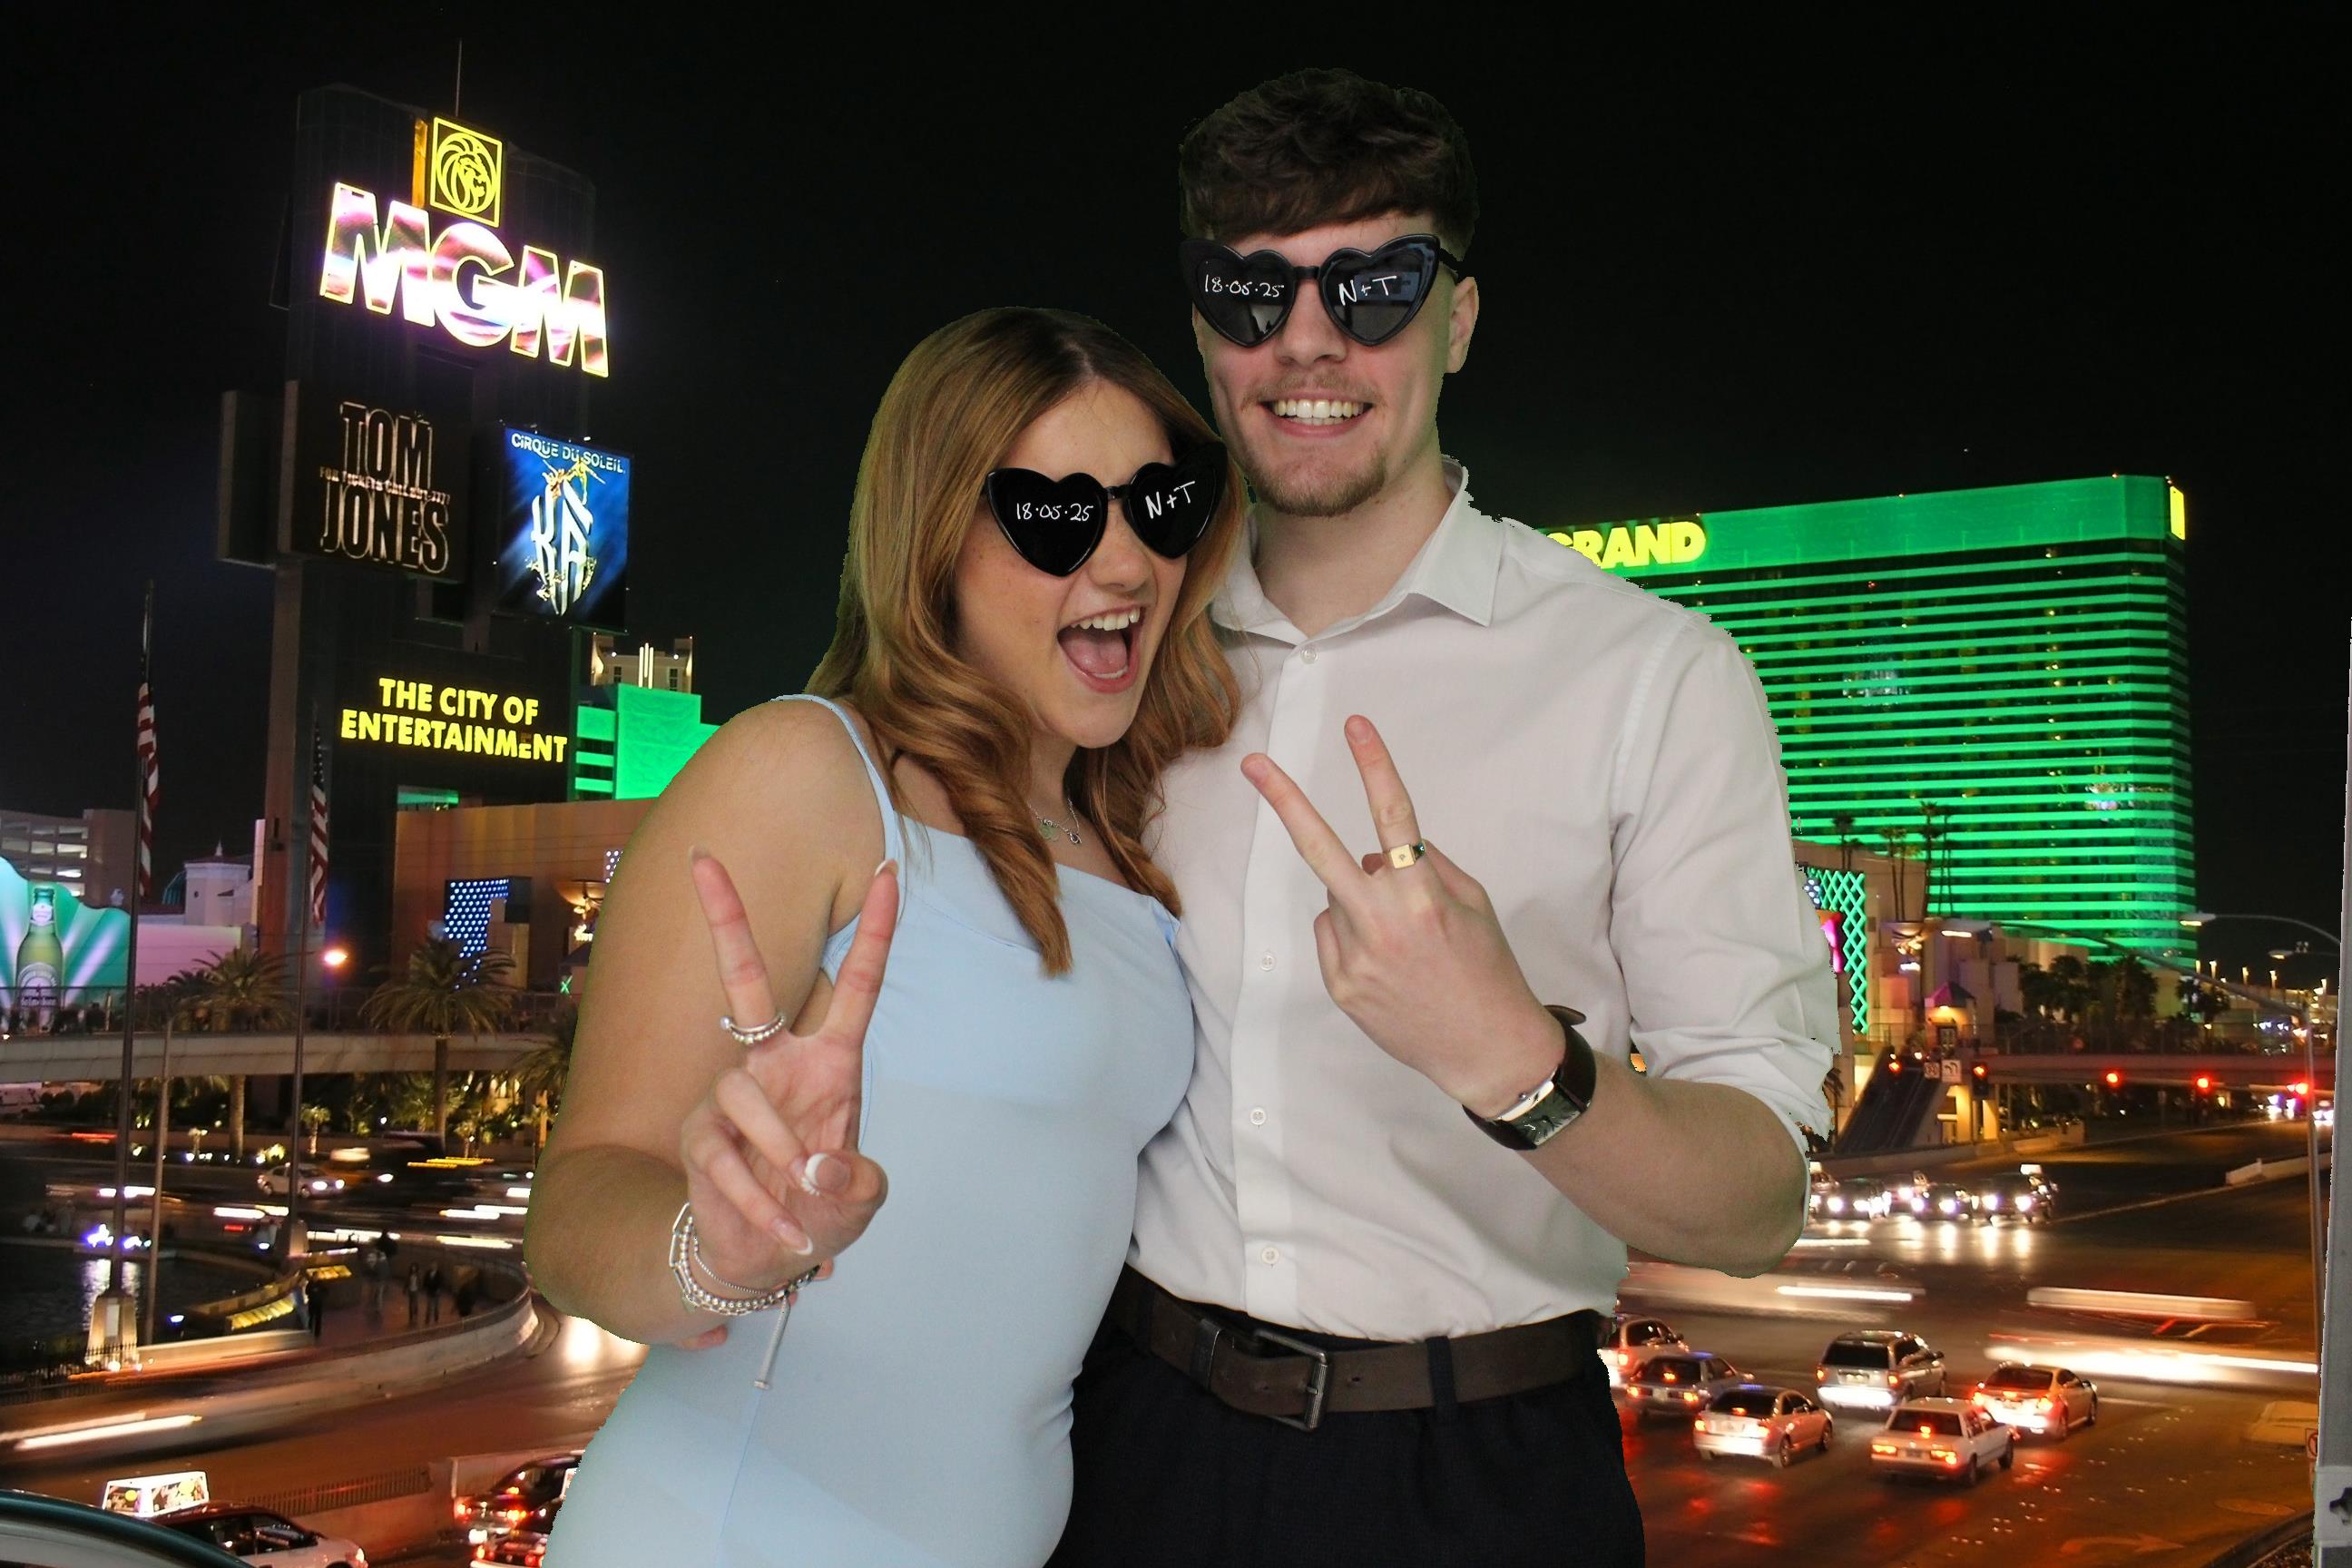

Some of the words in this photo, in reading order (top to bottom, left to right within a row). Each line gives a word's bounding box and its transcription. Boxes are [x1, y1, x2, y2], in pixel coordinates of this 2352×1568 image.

[320, 181, 610, 378] MGM
[1338, 275, 1397, 307] N+T
[339, 401, 433, 491] TOM
[511, 433, 559, 459] CIRQUE
[562, 446, 580, 463] DU
[583, 451, 623, 474] SOLEIL
[1144, 480, 1196, 520] N+T
[319, 479, 450, 573] JONES
[1546, 521, 1706, 570] RAND
[378, 677, 433, 712] THE
[439, 687, 498, 720] CITY
[503, 696, 538, 726] OF
[340, 709, 568, 763] ENTERTAINMENT
